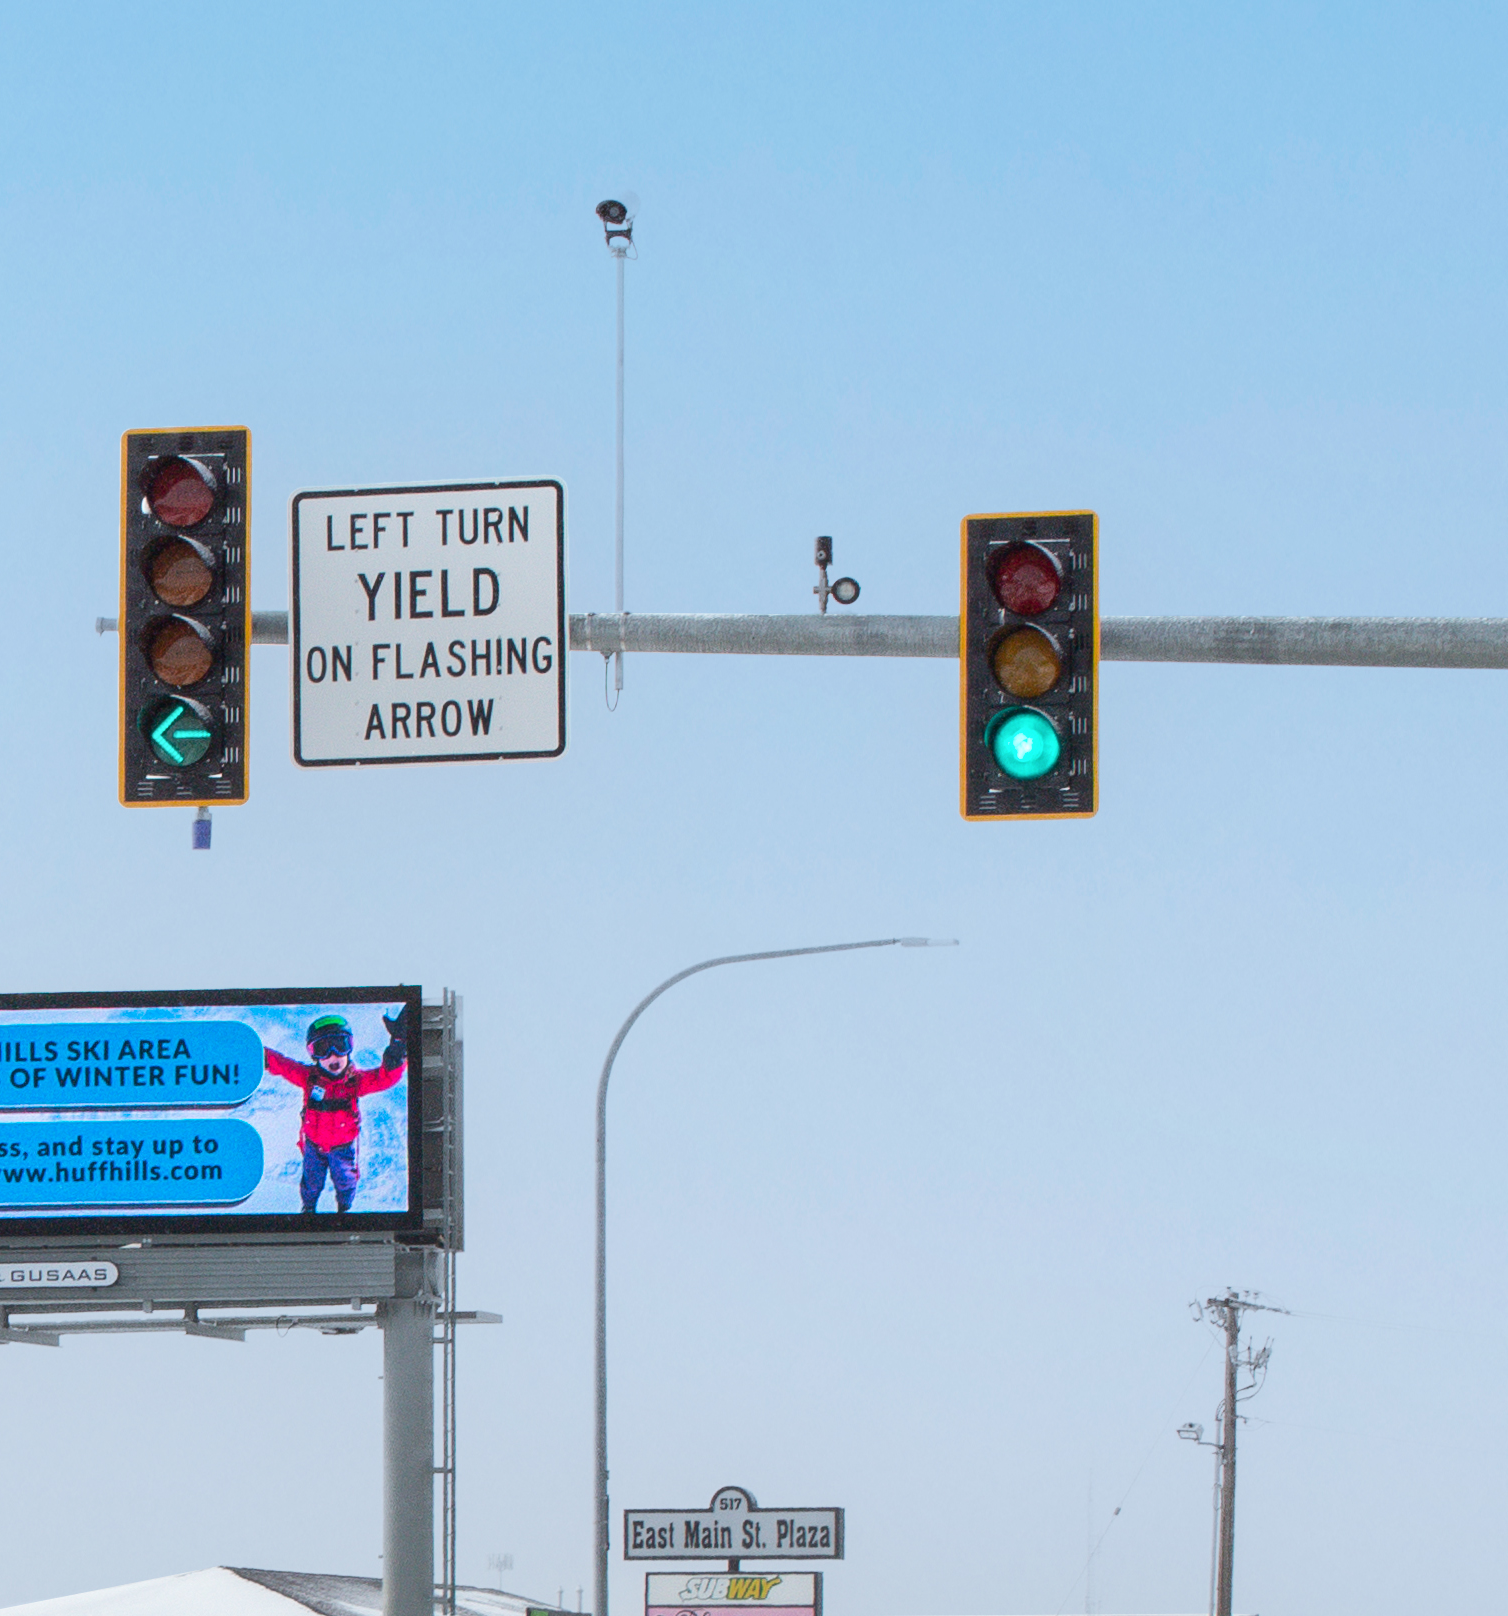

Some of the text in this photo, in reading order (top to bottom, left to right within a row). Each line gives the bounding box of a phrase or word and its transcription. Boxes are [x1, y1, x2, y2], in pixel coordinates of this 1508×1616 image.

[327, 505, 529, 551] LEFT TURN
[357, 567, 500, 621] YIELD
[306, 636, 552, 683] ON FLASHING
[364, 698, 494, 740] ARROW
[67, 1040, 109, 1062] SKI
[117, 1039, 191, 1061] AREA
[10, 1067, 47, 1088] OF
[55, 1065, 165, 1087] WINTER
[175, 1063, 240, 1086] FUN!
[38, 1136, 83, 1157] and
[92, 1136, 144, 1160] stay
[153, 1136, 183, 1158] up
[192, 1135, 219, 1154] to
[11, 1268, 107, 1282] GUSAAS
[719, 1498, 742, 1511] 517
[632, 1519, 831, 1549] East Main St. Plaza
[678, 1576, 783, 1601] SUBWAY
